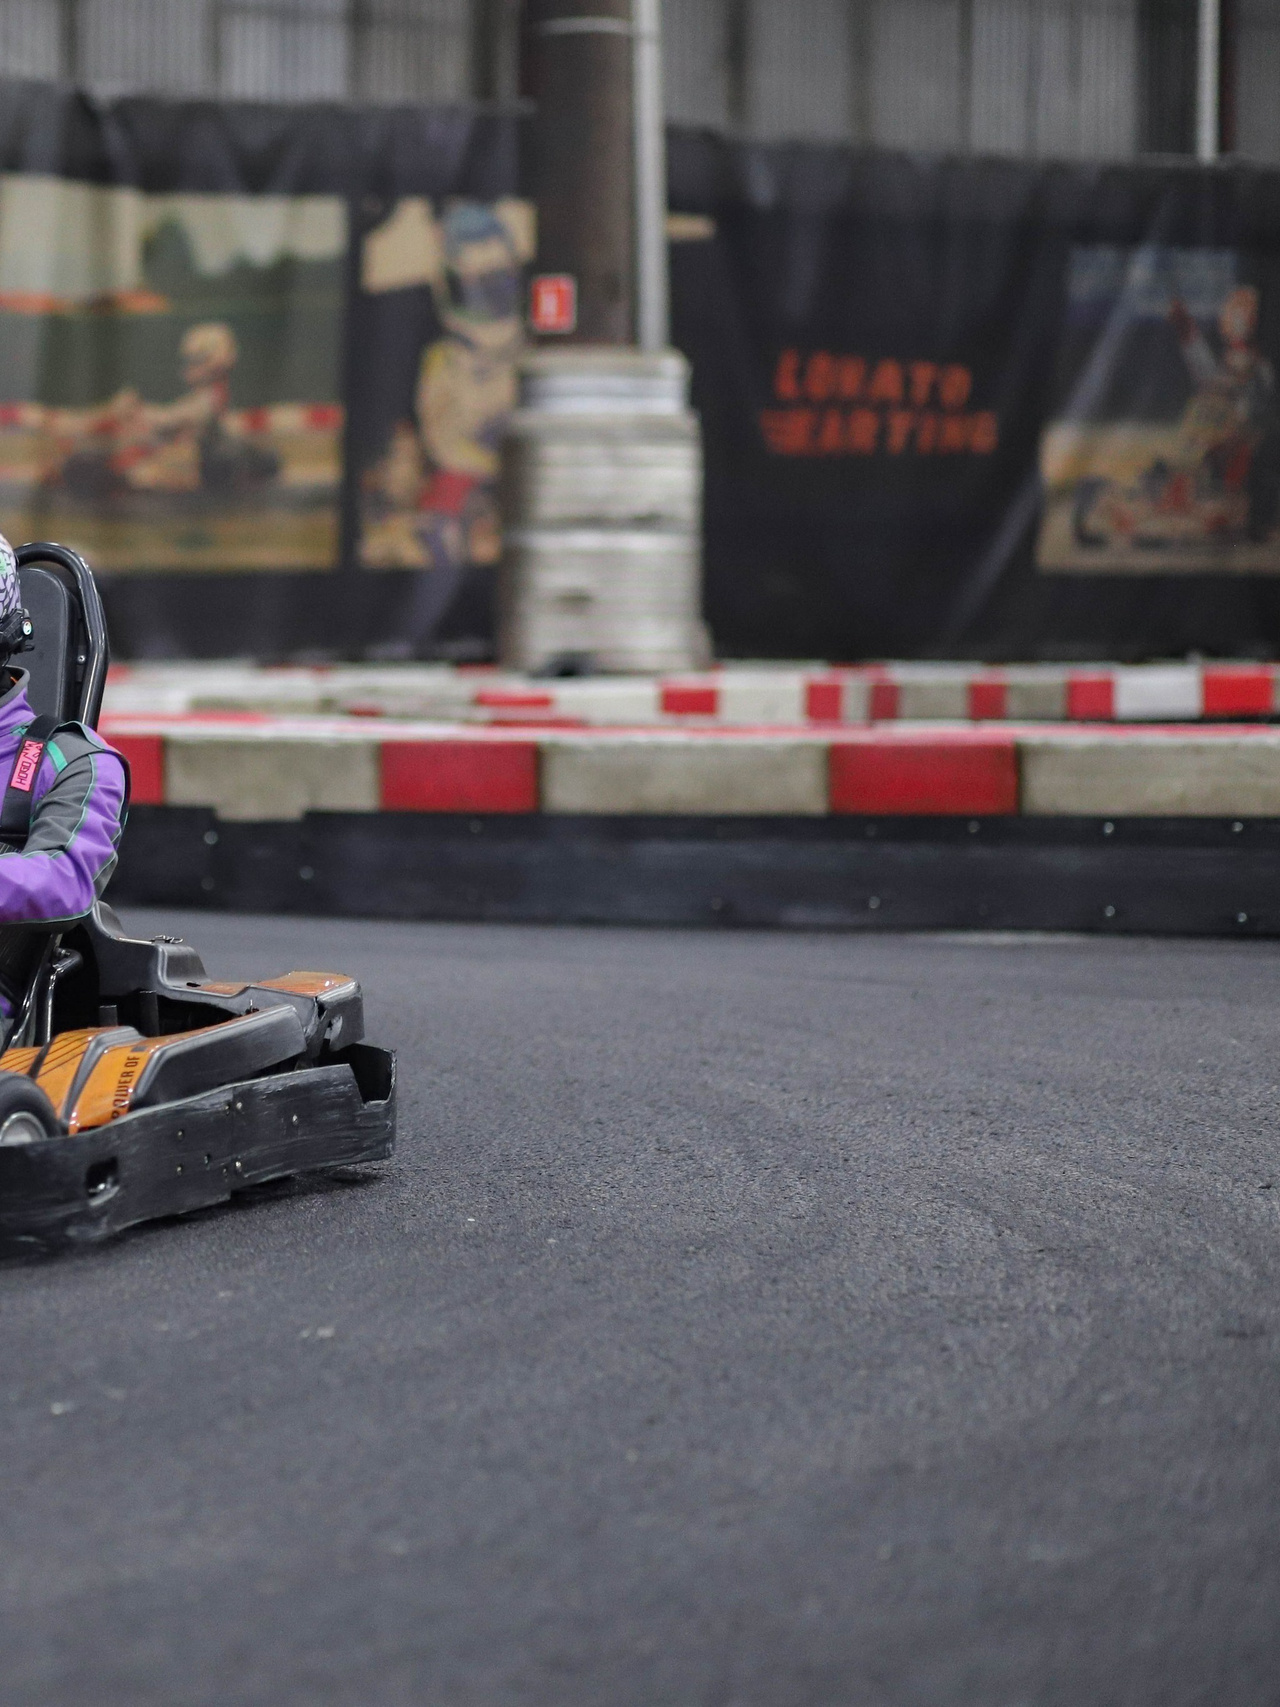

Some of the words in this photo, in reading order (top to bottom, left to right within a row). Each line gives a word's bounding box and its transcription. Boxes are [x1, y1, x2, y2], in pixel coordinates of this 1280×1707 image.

[775, 347, 972, 406] LONATO
[778, 409, 998, 456] KARTING
[124, 1056, 140, 1068] OF
